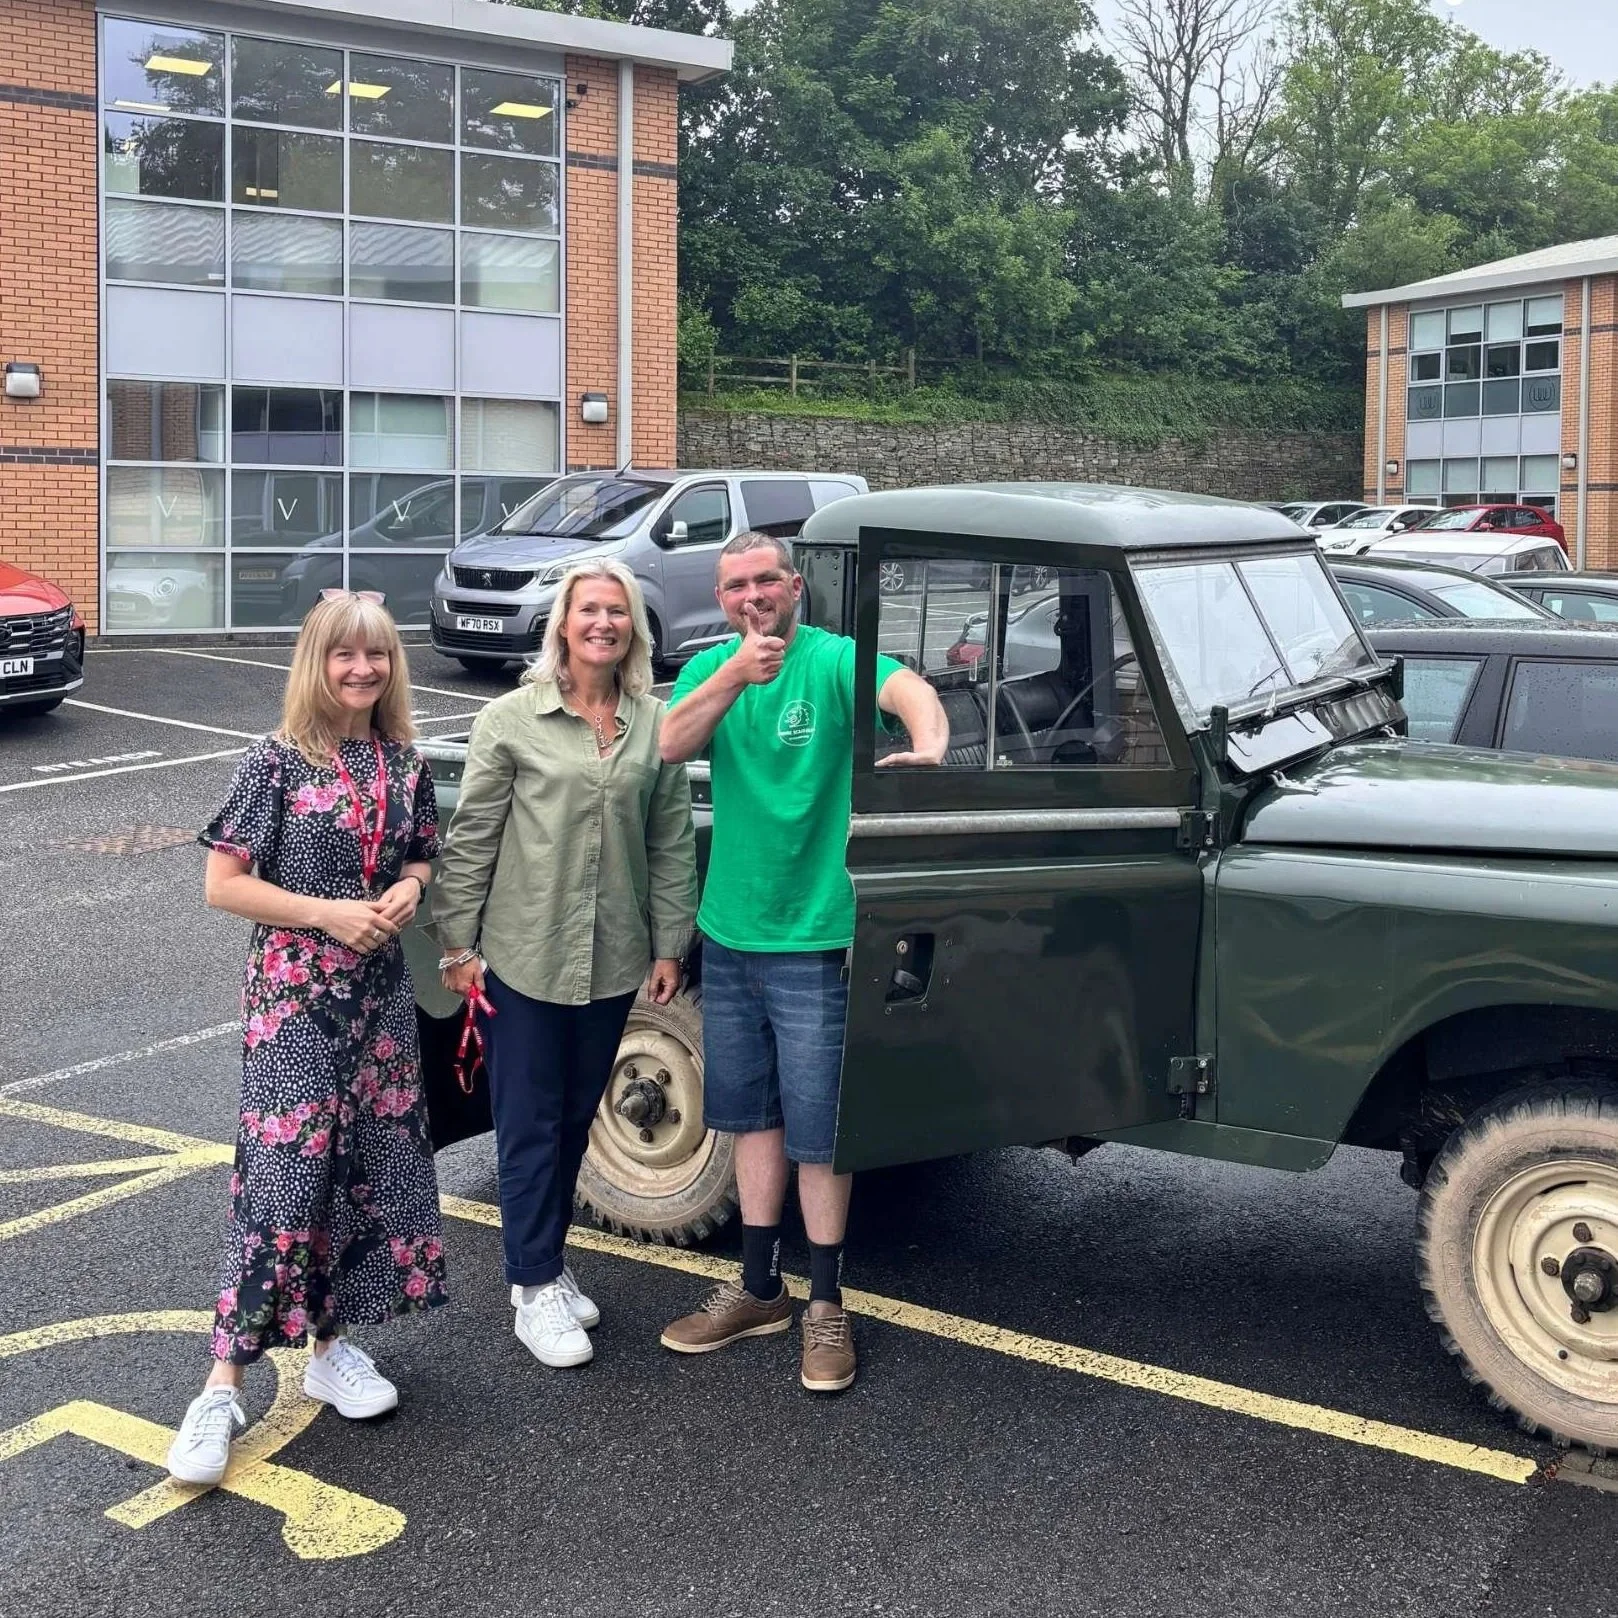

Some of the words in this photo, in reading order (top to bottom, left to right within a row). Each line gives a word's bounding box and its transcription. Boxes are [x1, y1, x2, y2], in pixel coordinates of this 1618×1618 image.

[277, 497, 298, 520] V
[392, 500, 412, 522] V
[460, 617, 482, 630] WF70
[483, 619, 500, 632] RSX
[3, 659, 29, 675] CLN
